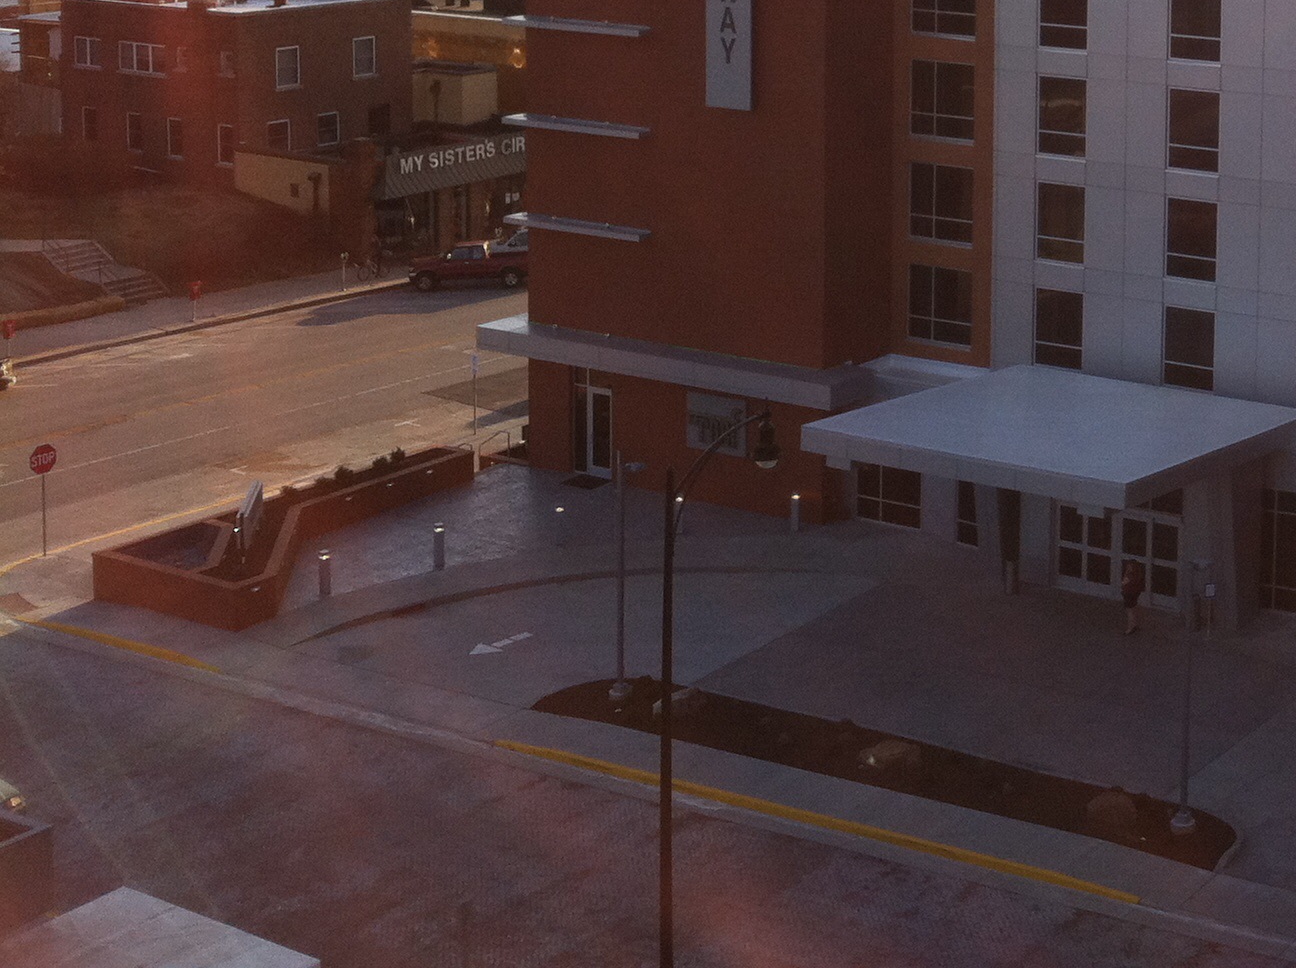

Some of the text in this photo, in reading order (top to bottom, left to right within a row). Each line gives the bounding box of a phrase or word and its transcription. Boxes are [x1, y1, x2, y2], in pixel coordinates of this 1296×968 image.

[400, 154, 424, 174] MY
[428, 141, 495, 168] SISTER'S
[31, 451, 54, 467] STOP
